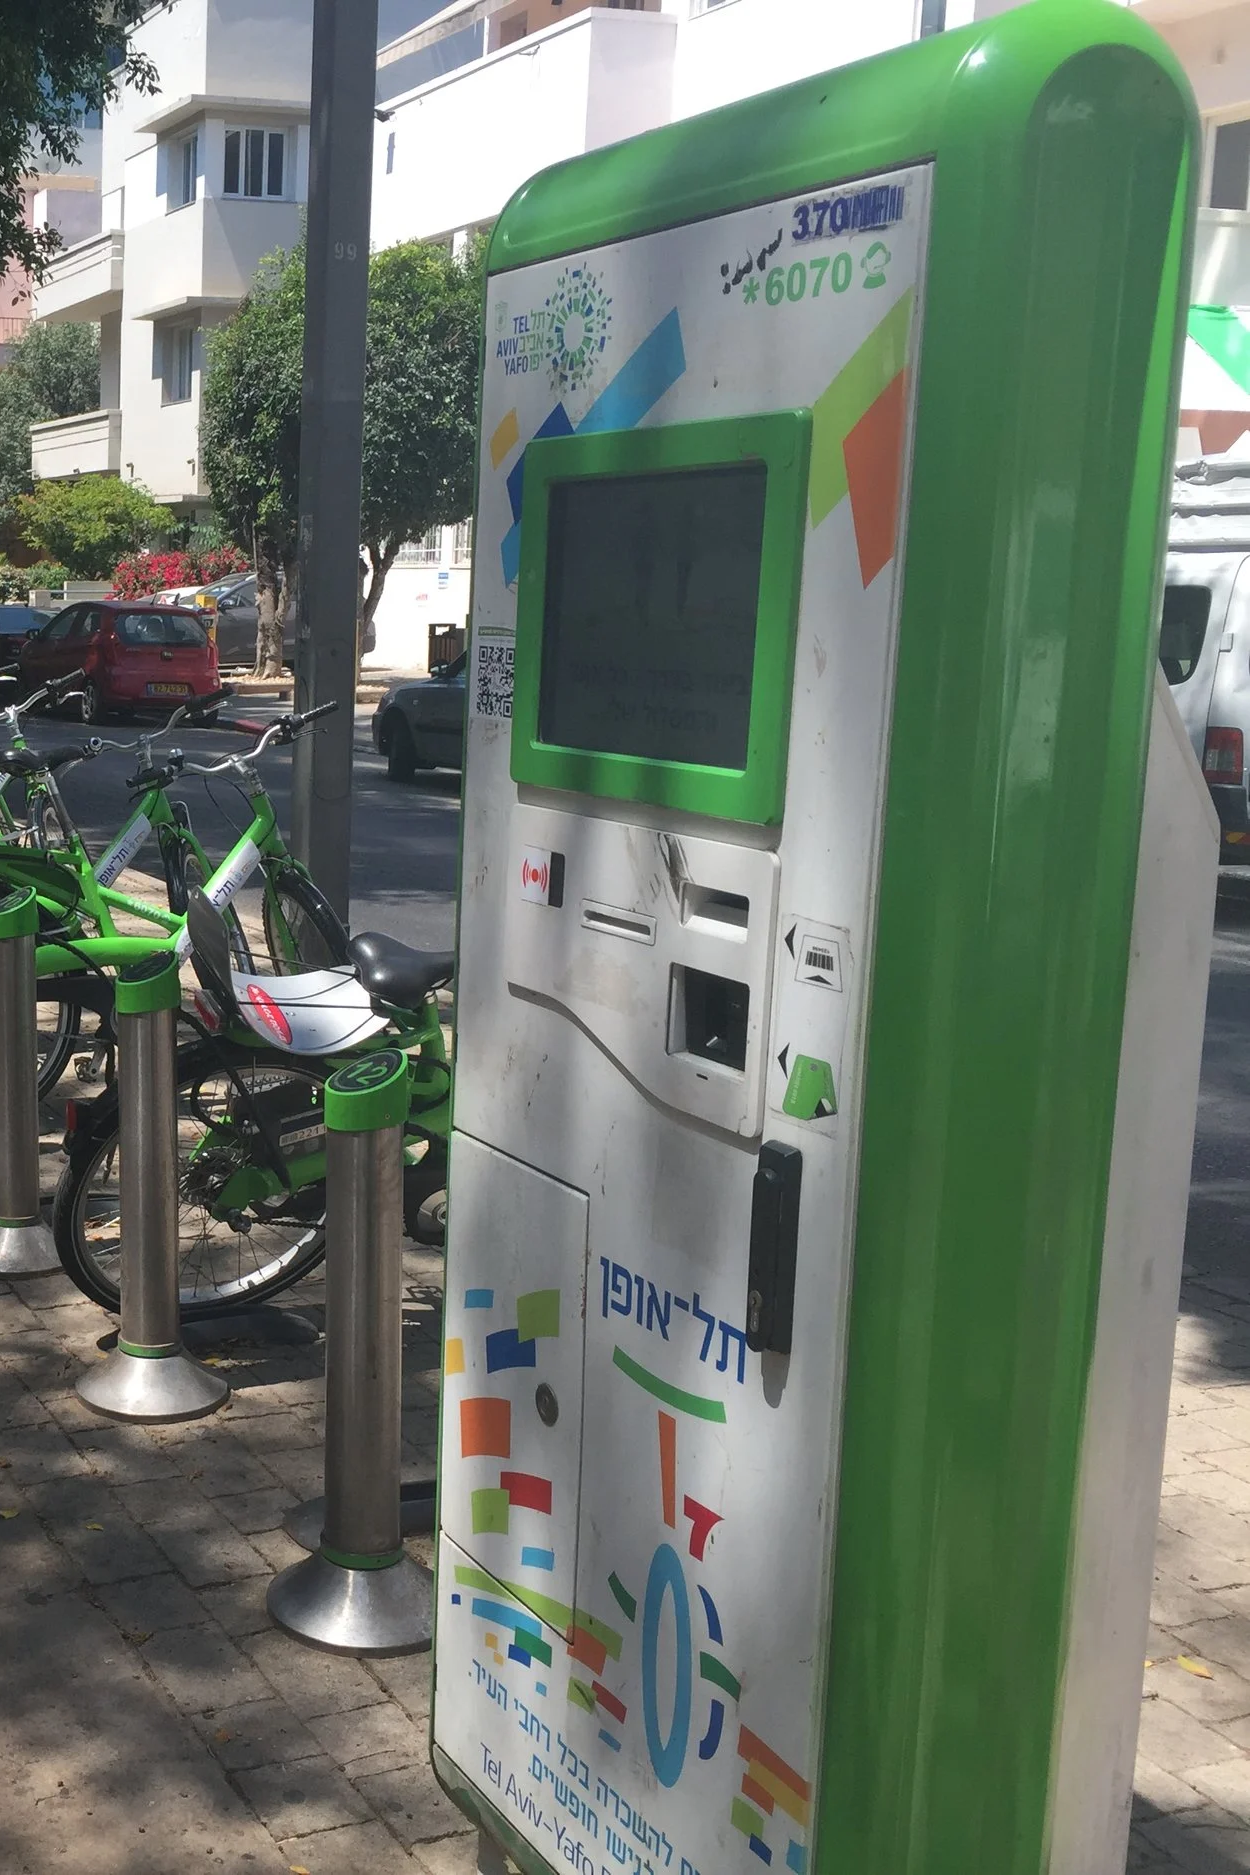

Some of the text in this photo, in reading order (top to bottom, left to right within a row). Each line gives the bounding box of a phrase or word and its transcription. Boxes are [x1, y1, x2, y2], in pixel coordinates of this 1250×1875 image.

[792, 197, 849, 240] 370
[334, 240, 358, 262] 99
[513, 314, 530, 335] TEL
[530, 309, 546, 330] תל
[496, 336, 519, 358] AVIV
[519, 332, 544, 353] אביב
[504, 355, 529, 376] YAFO
[347, 1061, 389, 1085] 12
[514, 1697, 551, 1753] רחבי
[480, 1742, 502, 1789] Tel
[556, 1731, 590, 1791] בכל
[596, 1776, 674, 1868] להשכרה
